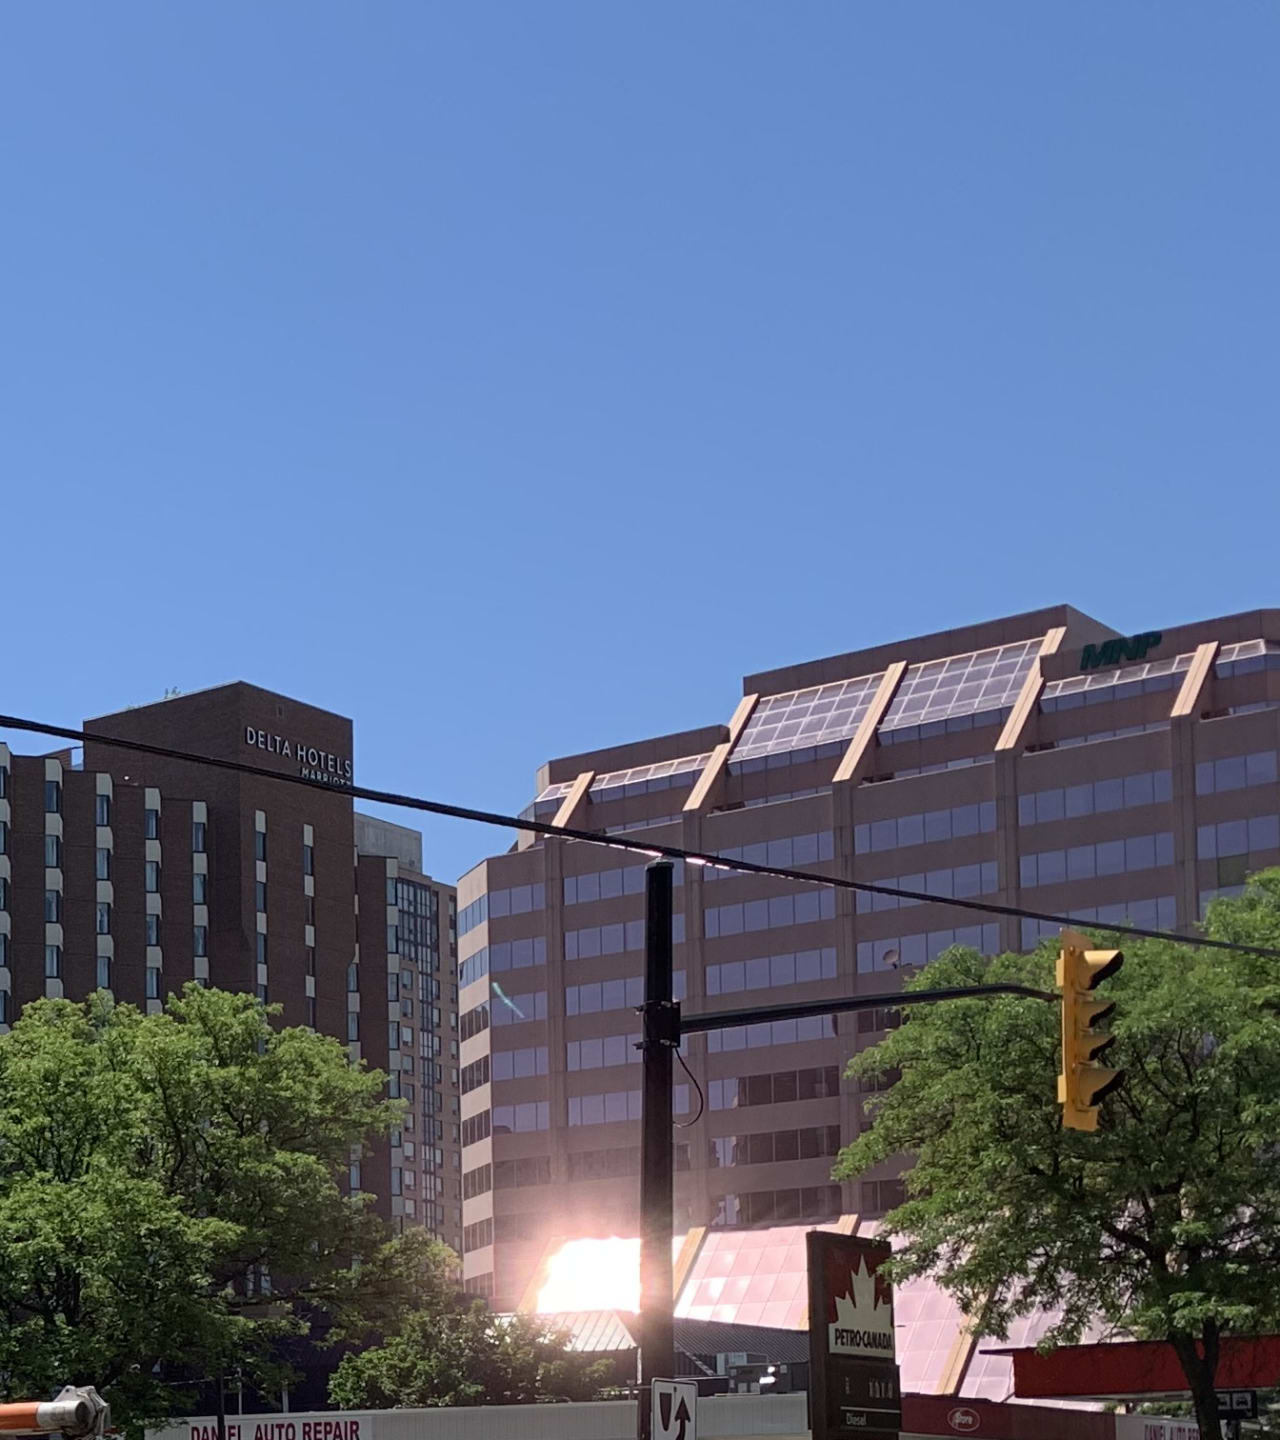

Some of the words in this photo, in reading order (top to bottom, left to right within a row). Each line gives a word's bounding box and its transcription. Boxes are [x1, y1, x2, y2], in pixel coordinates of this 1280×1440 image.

[1080, 631, 1162, 670] MNP
[246, 726, 291, 757] DELTA
[297, 744, 352, 777] HOTELS
[834, 1328, 894, 1350] PETRO-CANADA
[845, 1413, 867, 1426] Diesel
